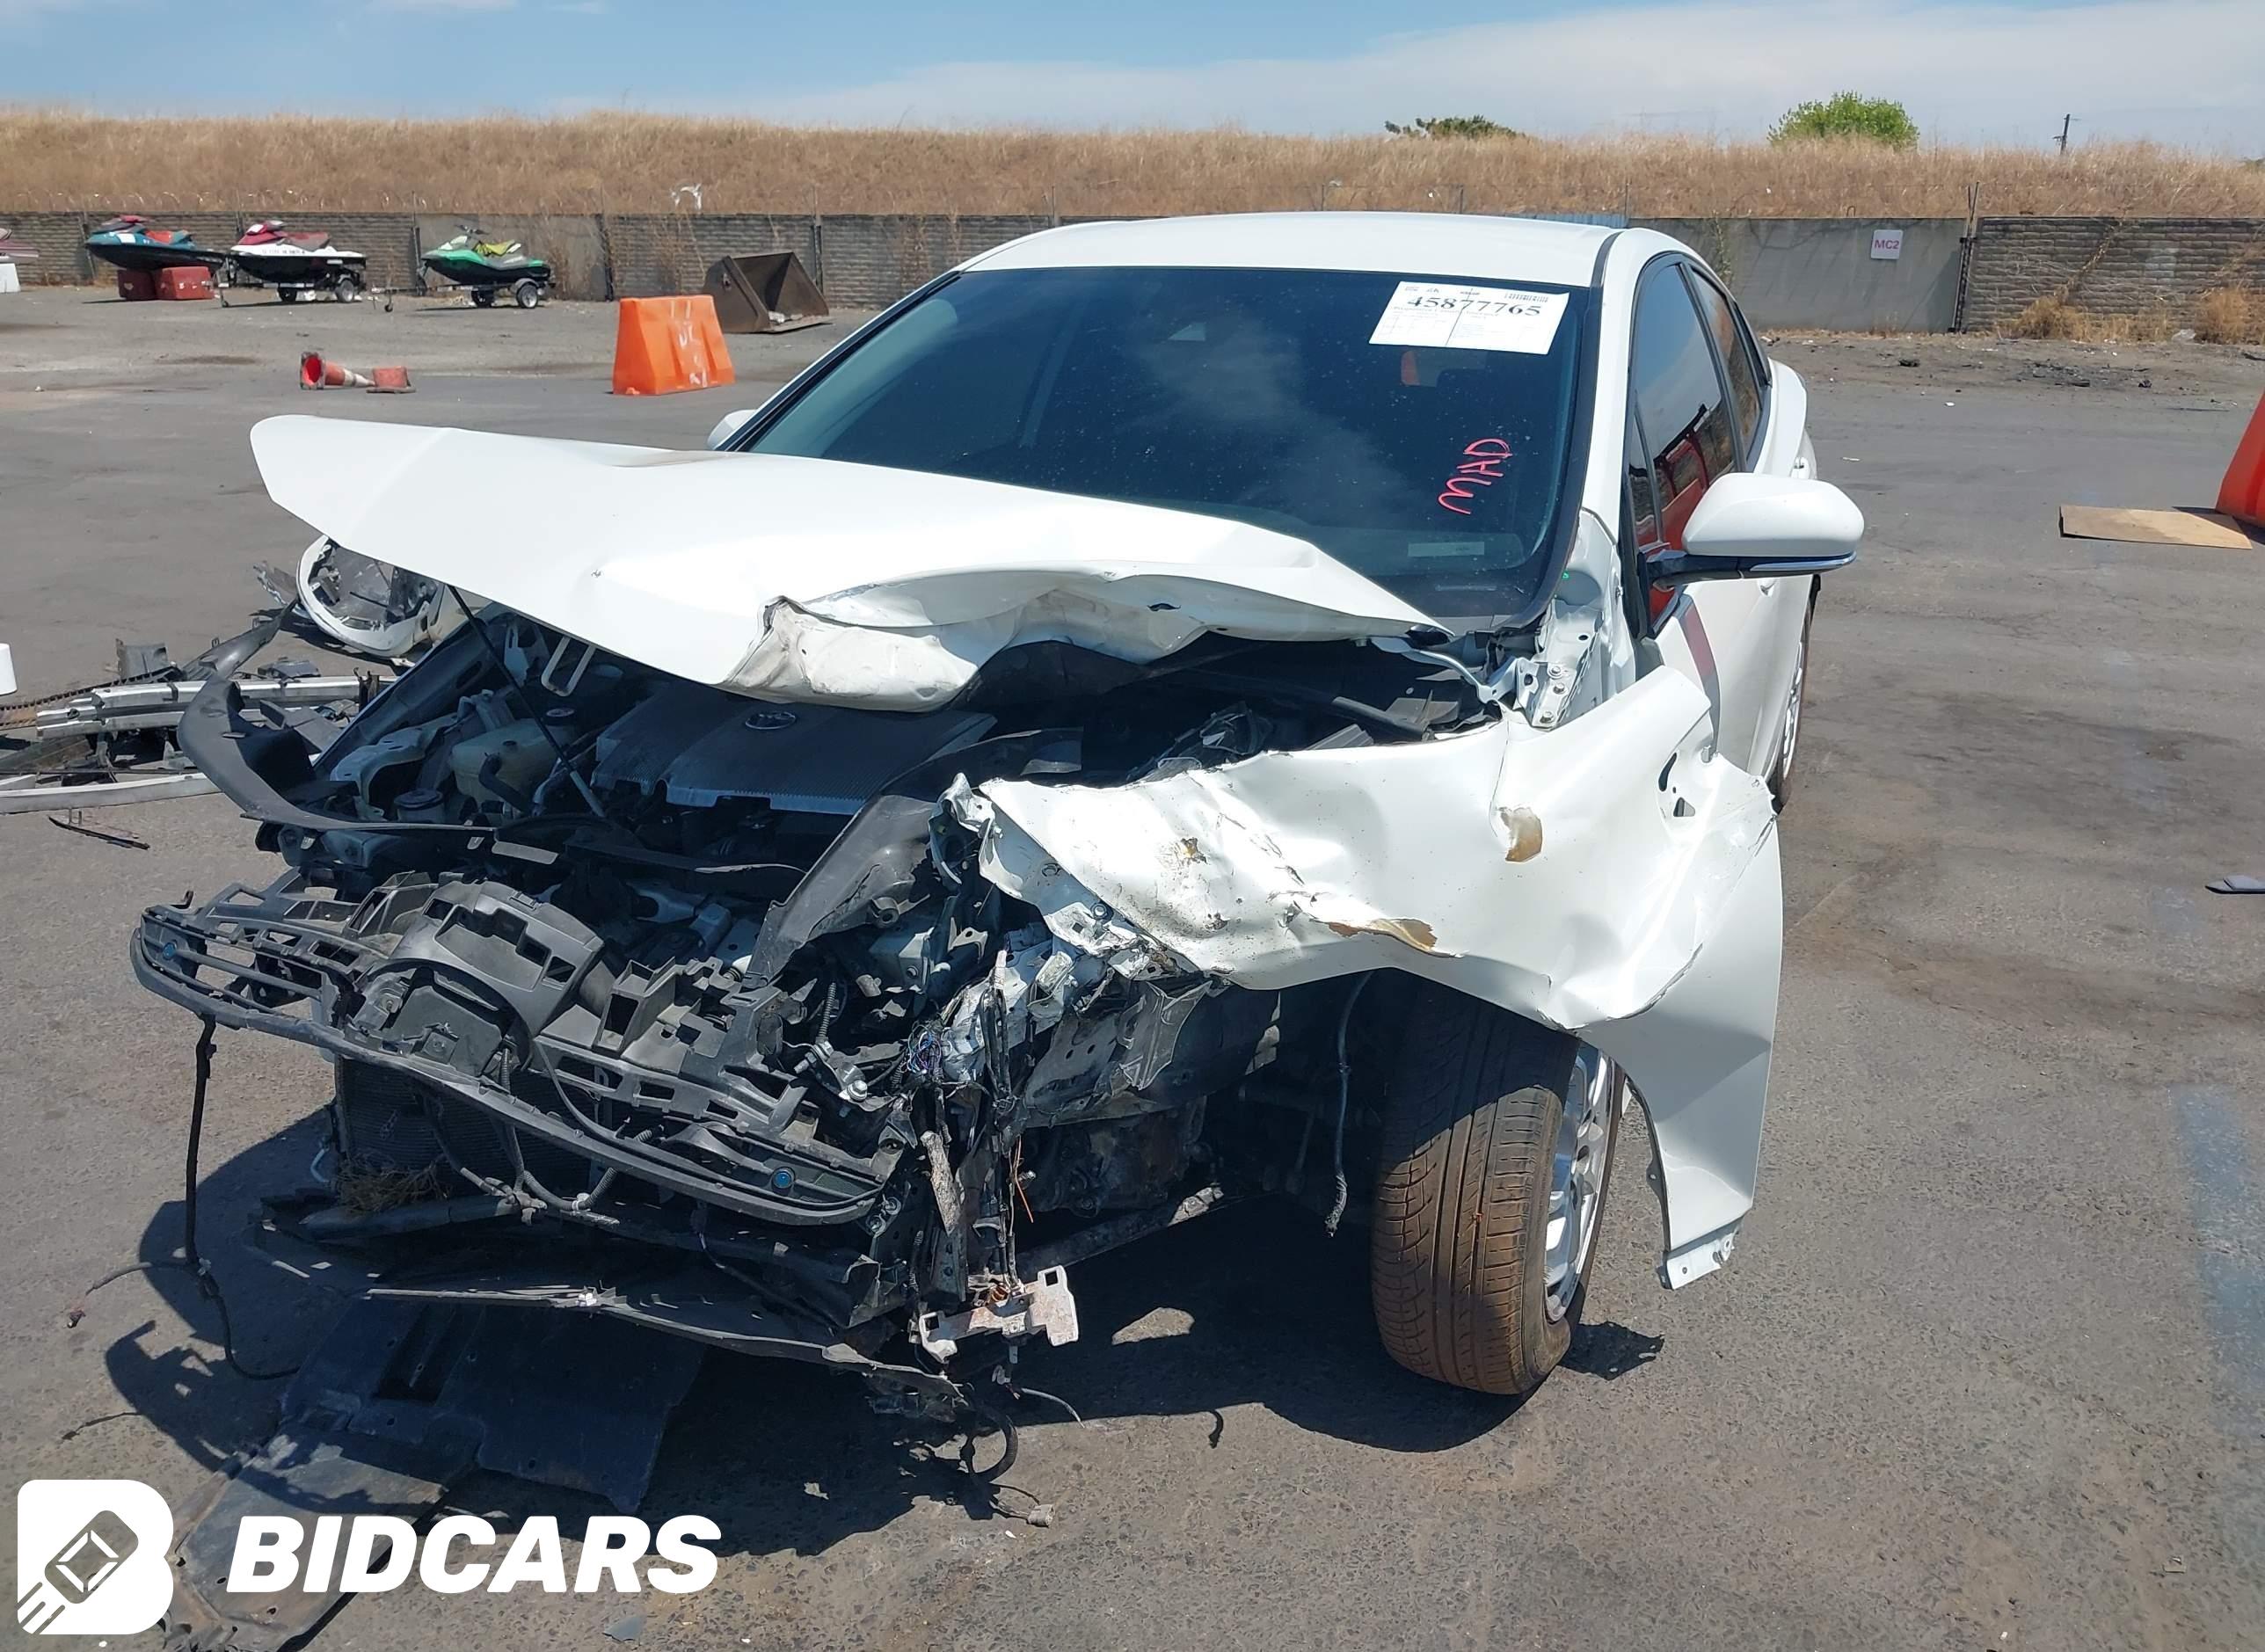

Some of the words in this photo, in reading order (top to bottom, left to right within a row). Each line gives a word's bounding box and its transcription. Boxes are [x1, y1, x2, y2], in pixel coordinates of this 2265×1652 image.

[1874, 239, 1900, 250] MC2
[1406, 295, 1541, 317] 45877765
[1438, 438, 1512, 515] MAD
